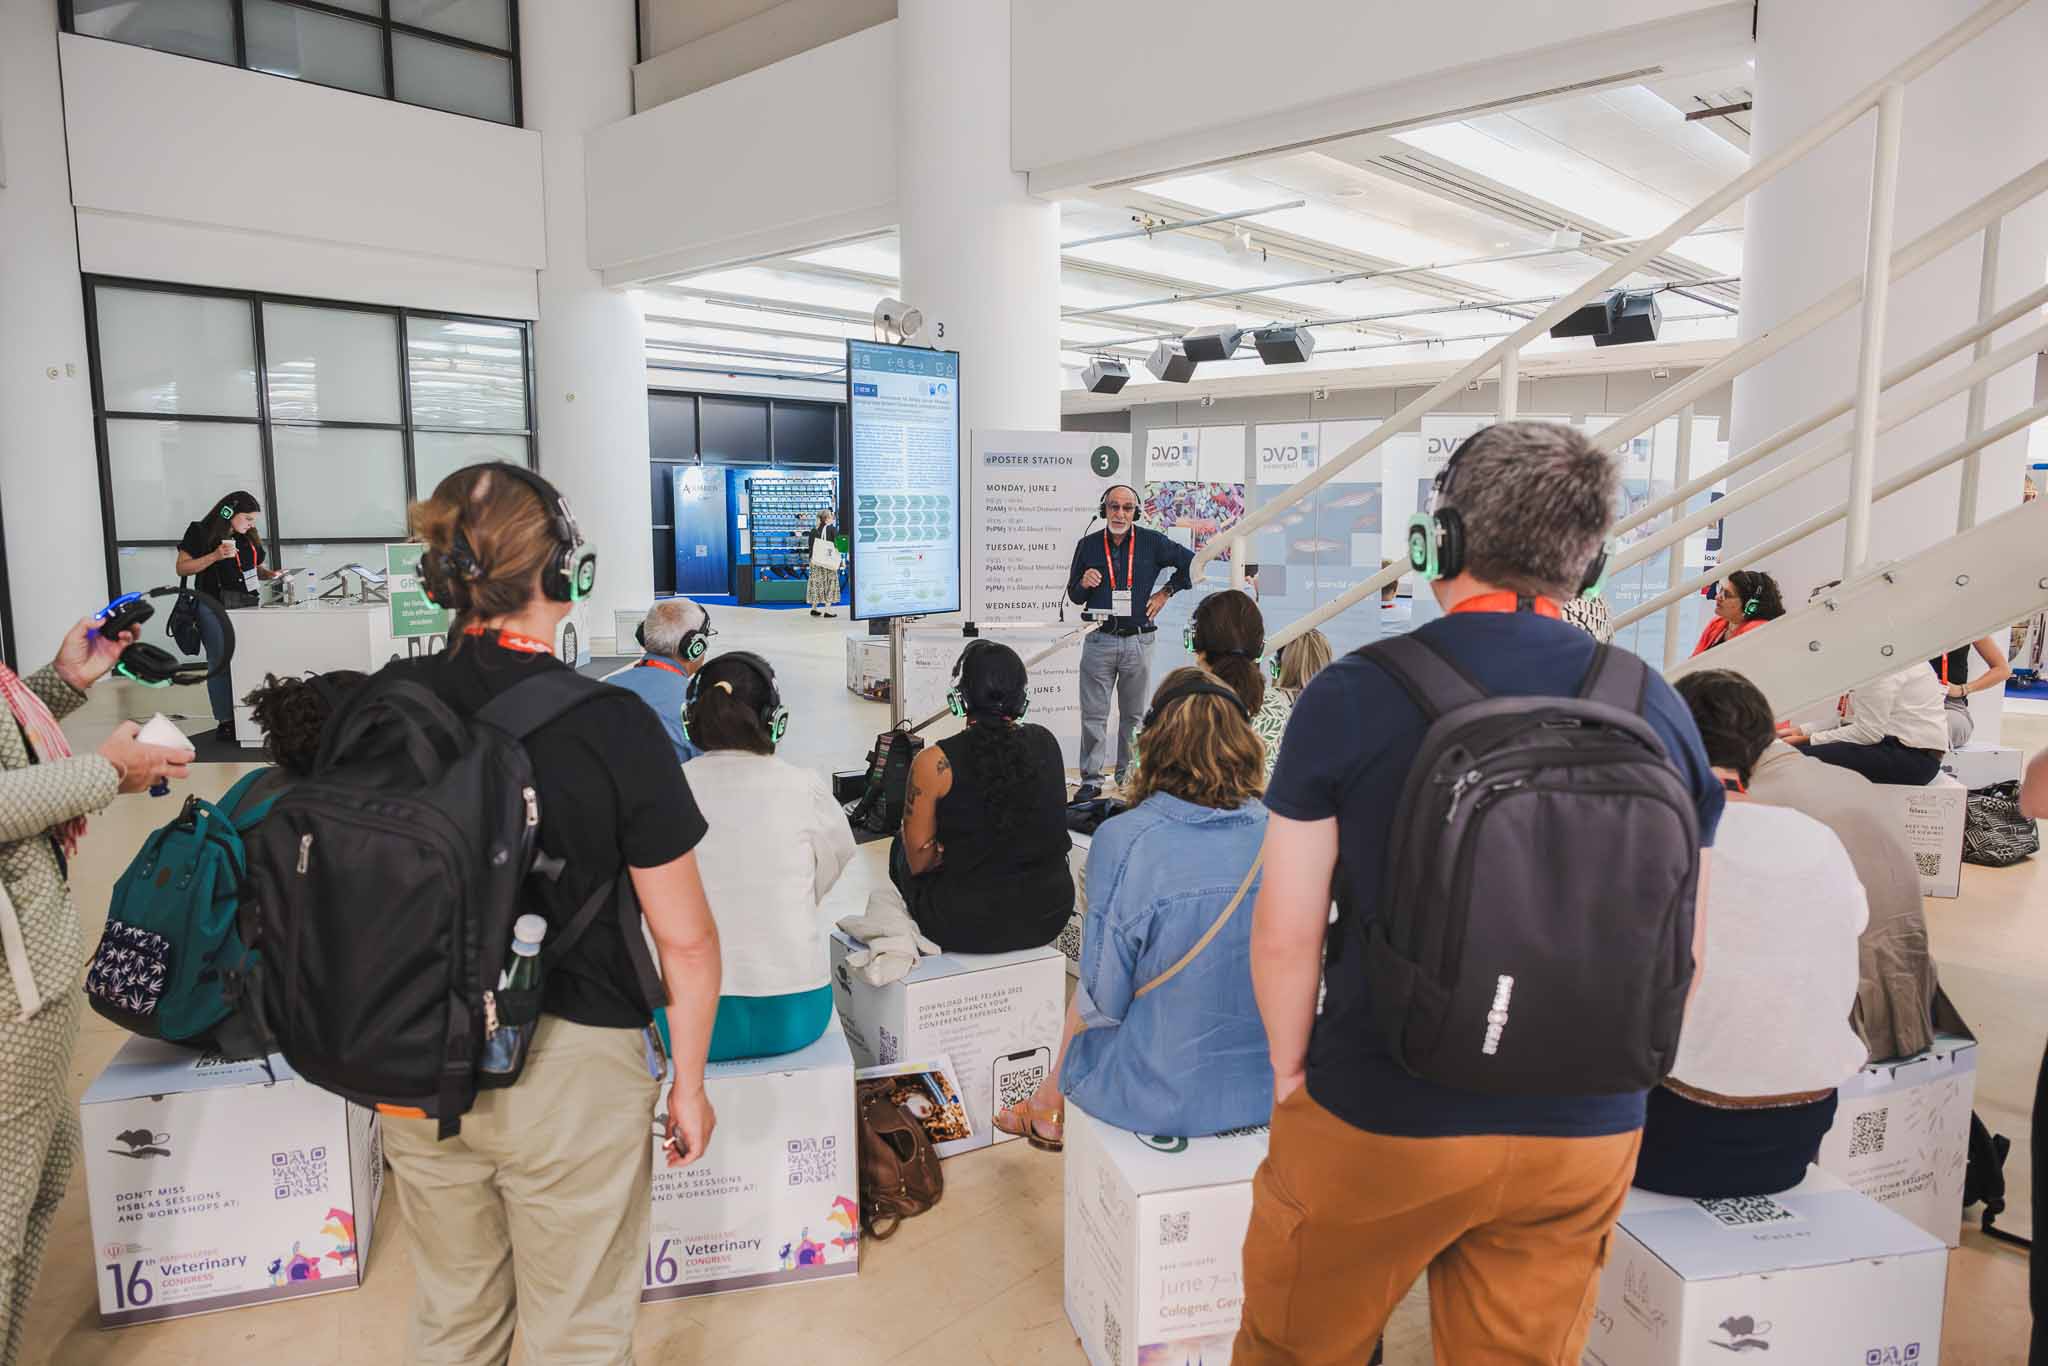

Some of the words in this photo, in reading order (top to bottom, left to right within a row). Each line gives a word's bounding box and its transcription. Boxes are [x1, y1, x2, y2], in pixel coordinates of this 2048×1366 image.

[937, 322, 944, 338] 3
[986, 456, 1029, 465] ePOSTER
[1032, 456, 1073, 465] STATION
[1100, 454, 1109, 470] 3
[986, 484, 1026, 493] MONDAY,
[1028, 484, 1050, 493] JUNE
[1052, 484, 1057, 492] 2
[985, 543, 1026, 551] TUESDAY,
[1028, 543, 1049, 552] JUNE
[1042, 601, 1062, 610] JUNE
[919, 999, 962, 1012] DOWNLOAD
[964, 995, 977, 1003] THE
[935, 1010, 950, 1018] AND
[953, 1003, 987, 1014] ENHANCE
[990, 997, 1008, 1006] YOUR
[919, 1015, 967, 1030] CONFERENCE
[969, 1006, 1011, 1019] EXPERIENCE
[687, 1168, 712, 1177] MISS
[693, 1176, 742, 1187] SESSIONS
[115, 1190, 152, 1202] DON'T
[158, 1186, 186, 1195] MISS
[677, 1186, 739, 1200] WORKSHOPS
[743, 1184, 758, 1193] AT:
[117, 1200, 161, 1212] HSBLAS
[166, 1192, 221, 1206] SESSIONS
[118, 1212, 143, 1223] AND
[147, 1202, 219, 1218] WORKSHOPS
[223, 1200, 240, 1208] AT:
[685, 1238, 761, 1256] Veterinary
[160, 1255, 247, 1276] Veterinary
[1160, 1278, 1203, 1300] June
[1160, 1303, 1213, 1319] Cologne,
